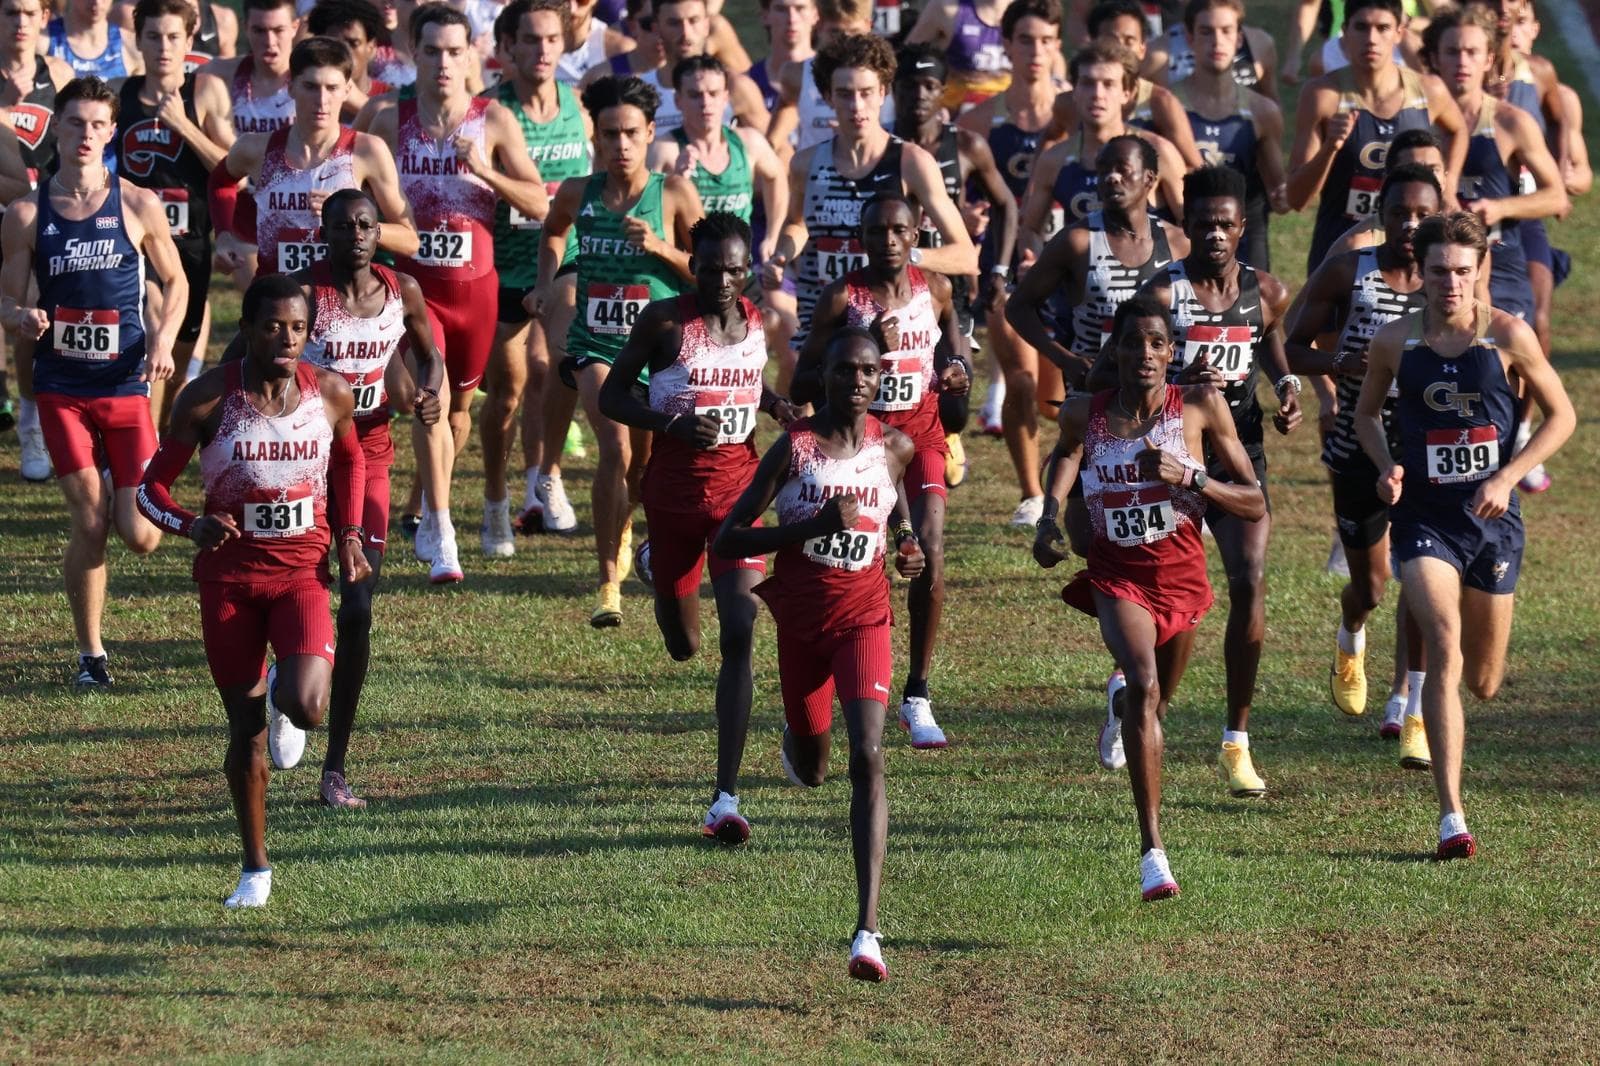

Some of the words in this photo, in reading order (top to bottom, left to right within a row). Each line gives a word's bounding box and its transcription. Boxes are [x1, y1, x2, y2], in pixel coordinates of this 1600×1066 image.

[233, 115, 297, 133] ALABAM
[136, 129, 171, 143] WKU
[526, 142, 583, 162] ETSON
[401, 154, 471, 176] ALABAM
[268, 191, 311, 211] ALAB
[822, 199, 866, 214] MIDD
[812, 212, 862, 227] TENNE
[63, 238, 115, 260] SOUTH
[418, 233, 464, 259] 332
[580, 235, 646, 257] STETS
[49, 253, 124, 277] ALABAMA
[594, 300, 640, 327] 448
[61, 325, 110, 352] 436
[322, 340, 396, 361] ALABAM
[352, 385, 376, 410] 40
[883, 375, 913, 403] 35
[231, 440, 319, 461] ALABAMA
[1436, 445, 1490, 475] 399
[1095, 463, 1145, 484] ALAB
[255, 501, 303, 530] 331
[1112, 505, 1166, 539] 334
[813, 531, 869, 562] 338
